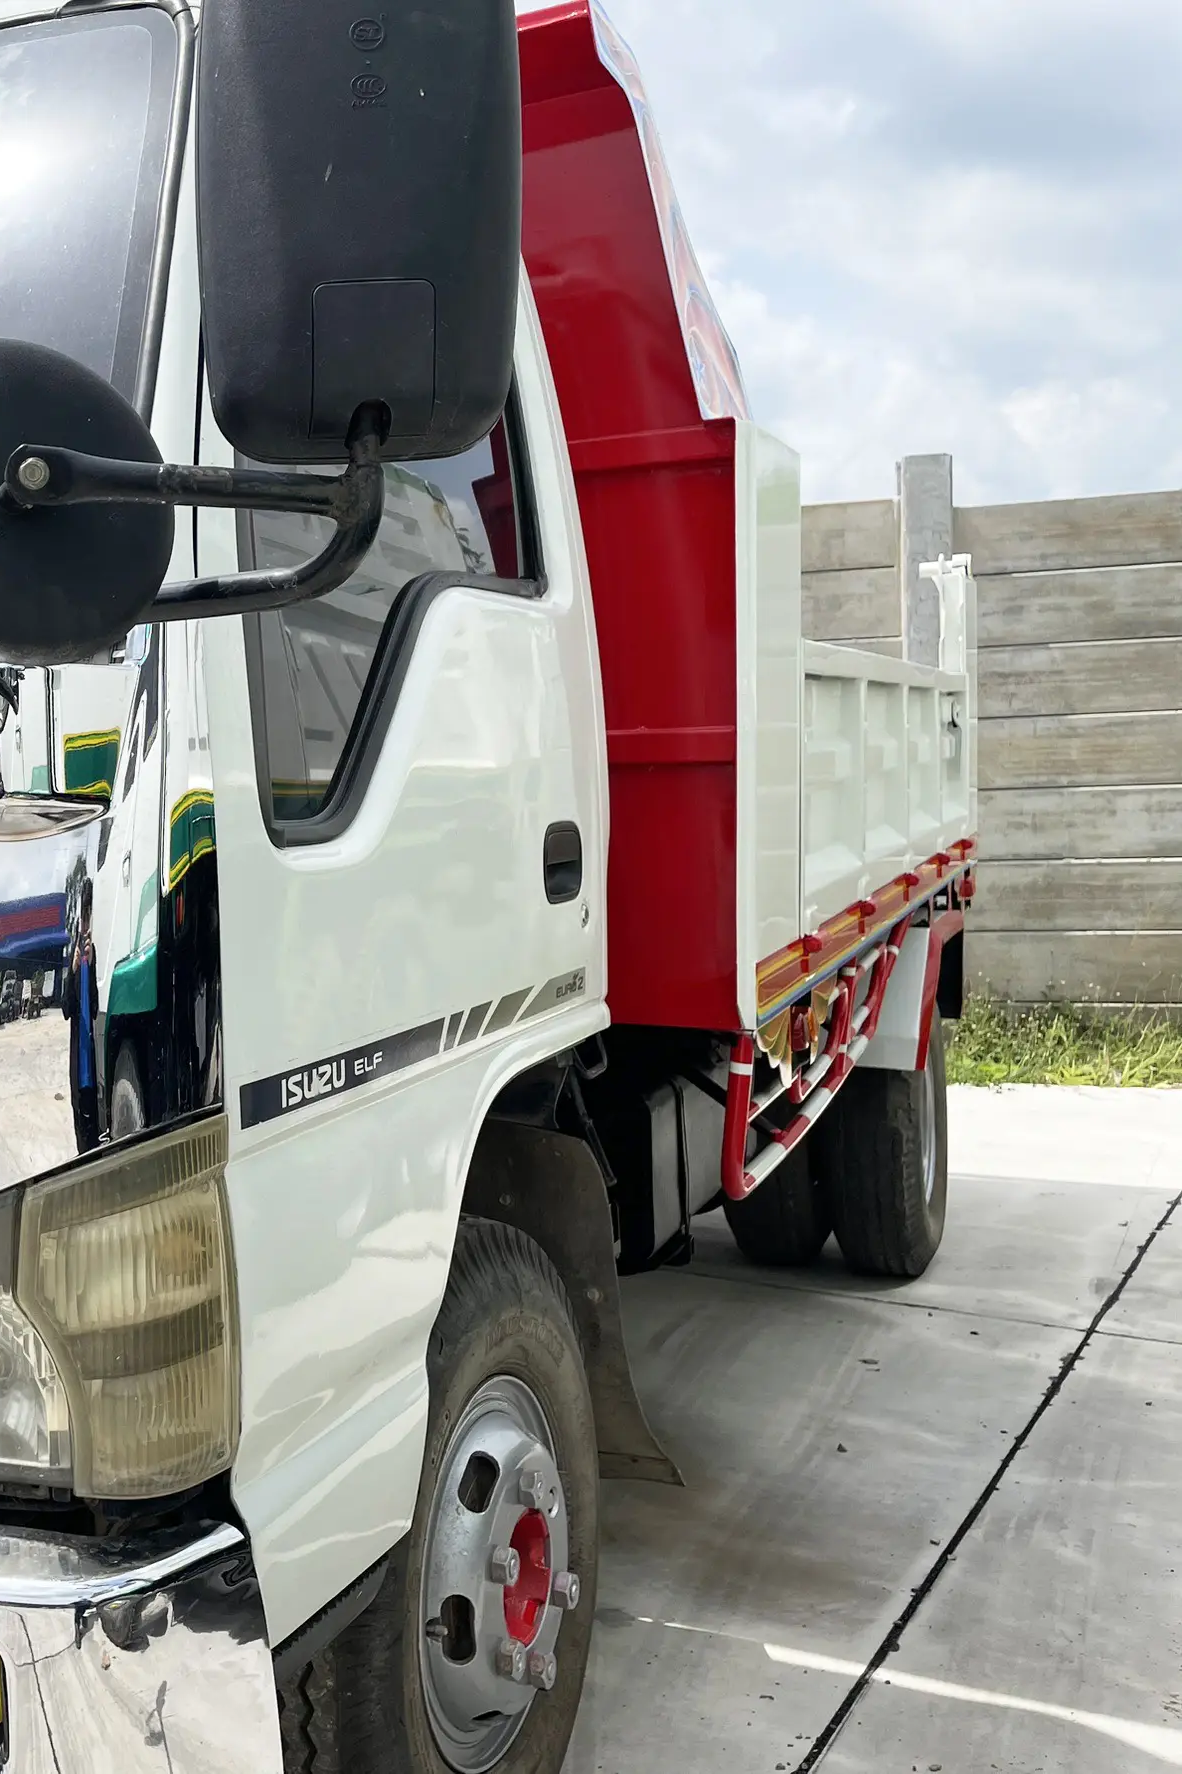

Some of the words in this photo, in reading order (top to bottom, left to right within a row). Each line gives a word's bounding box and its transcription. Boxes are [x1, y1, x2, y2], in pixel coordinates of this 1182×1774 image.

[577, 975, 584, 991] 2
[280, 1058, 346, 1109] ISUZU
[353, 1051, 383, 1077] ELF
